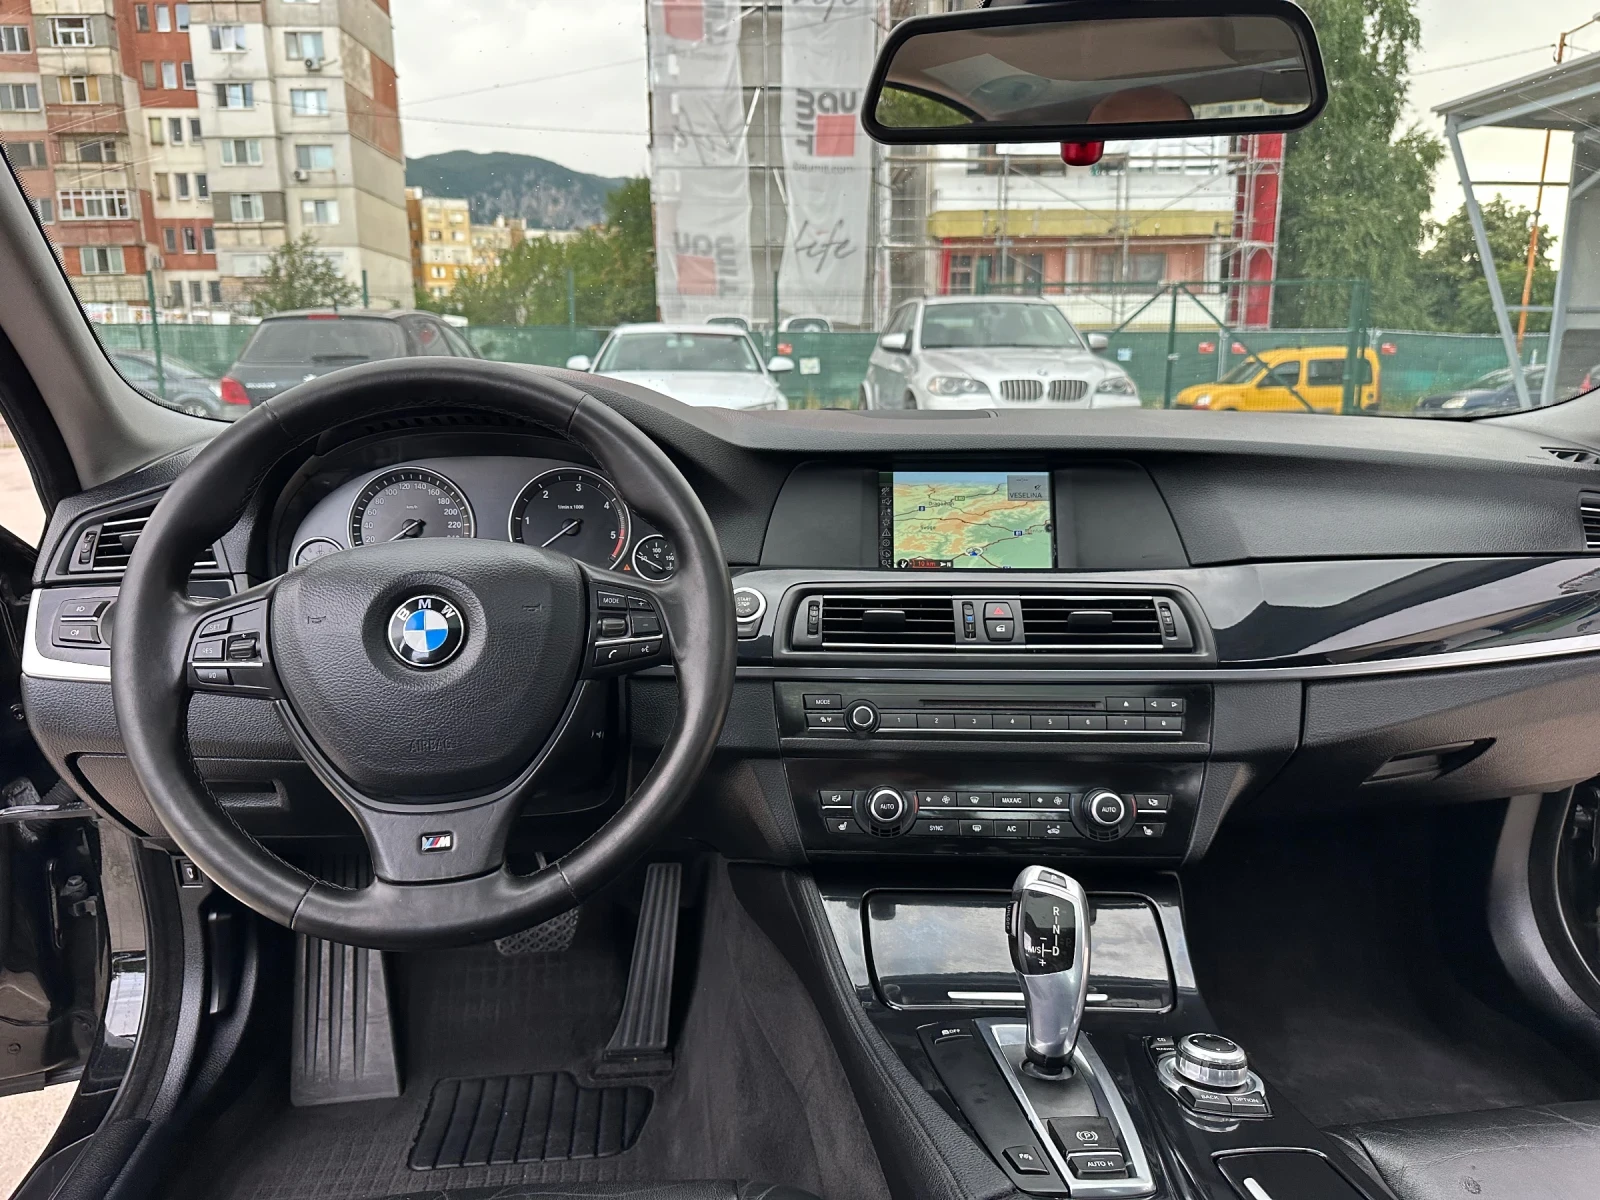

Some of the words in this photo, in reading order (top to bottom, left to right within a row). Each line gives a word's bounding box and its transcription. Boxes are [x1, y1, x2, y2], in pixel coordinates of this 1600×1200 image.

[385, 488, 398, 496] 100
[428, 488, 440, 496] 160
[576, 484, 582, 492] 3
[542, 490, 548, 498] 2
[604, 501, 610, 510] 4
[367, 508, 377, 516] 60
[444, 508, 458, 516] 200
[525, 516, 530, 524] 1
[610, 531, 616, 539] 5
[603, 596, 620, 604] MODE
[397, 598, 456, 621] BMW
[410, 740, 452, 752] AIRBAG
[1052, 906, 1060, 916] R
[1052, 924, 1060, 934] N
[1028, 946, 1042, 954] M/S
[1052, 946, 1060, 956] D
